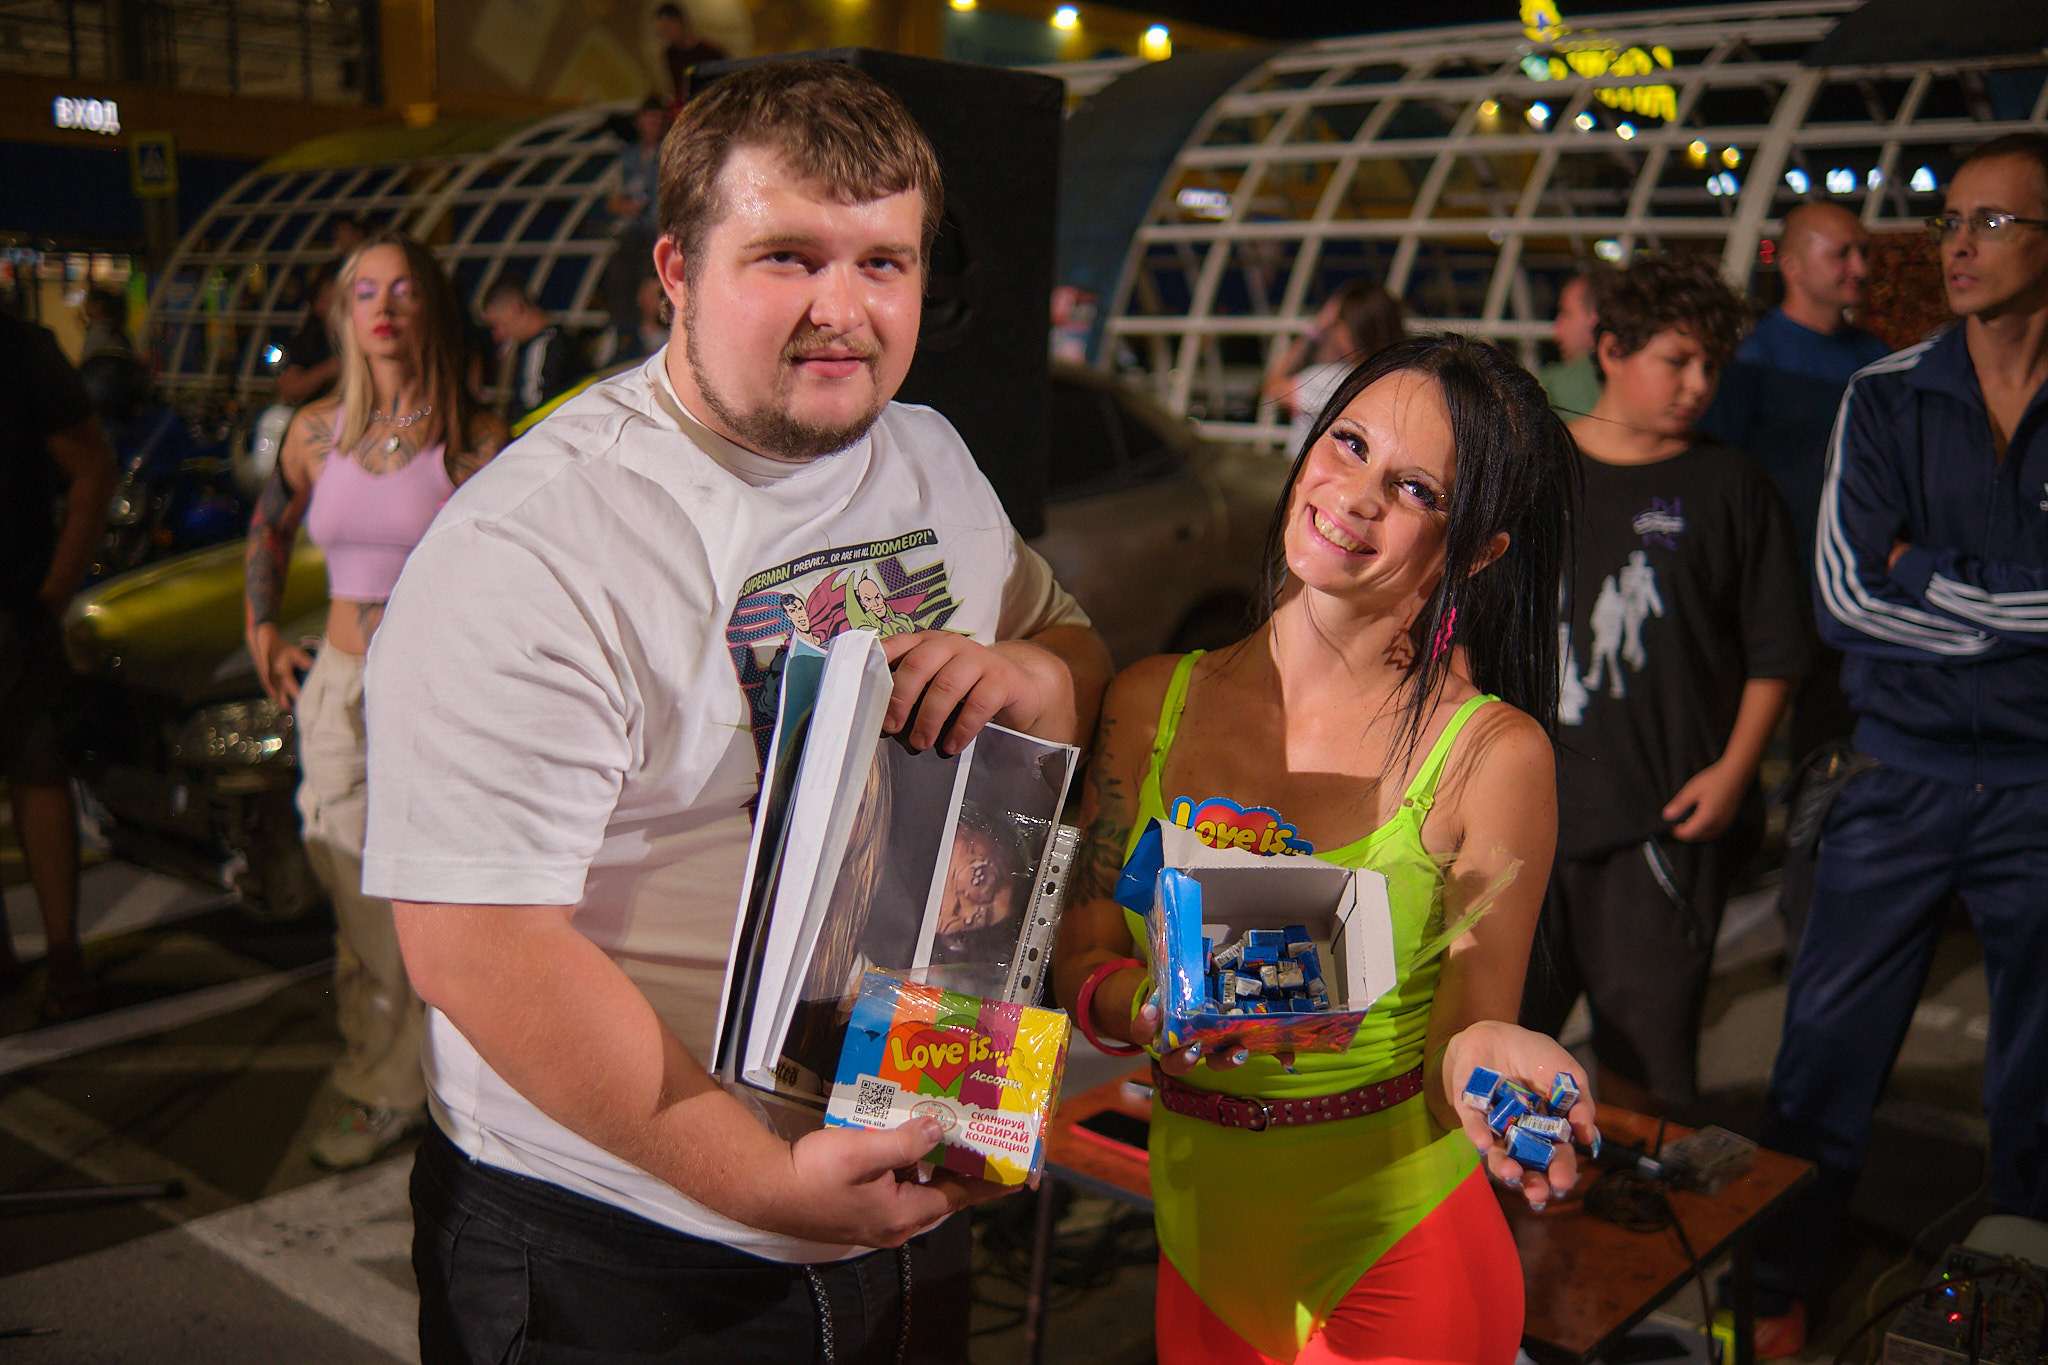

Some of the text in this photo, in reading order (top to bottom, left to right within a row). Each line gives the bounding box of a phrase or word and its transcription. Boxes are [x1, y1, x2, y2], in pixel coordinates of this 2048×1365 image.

[54, 96, 120, 135] ВХОД
[743, 564, 791, 596] SUPERMAN
[830, 553, 841, 563] OR
[841, 551, 854, 561] ARE
[890, 1037, 965, 1072] Love
[968, 1121, 1030, 1144] СОБИРАЙ
[971, 1111, 1026, 1131] СКАНИРУЙ
[965, 1131, 1030, 1155] КОЛЛЕКЦИЮ
